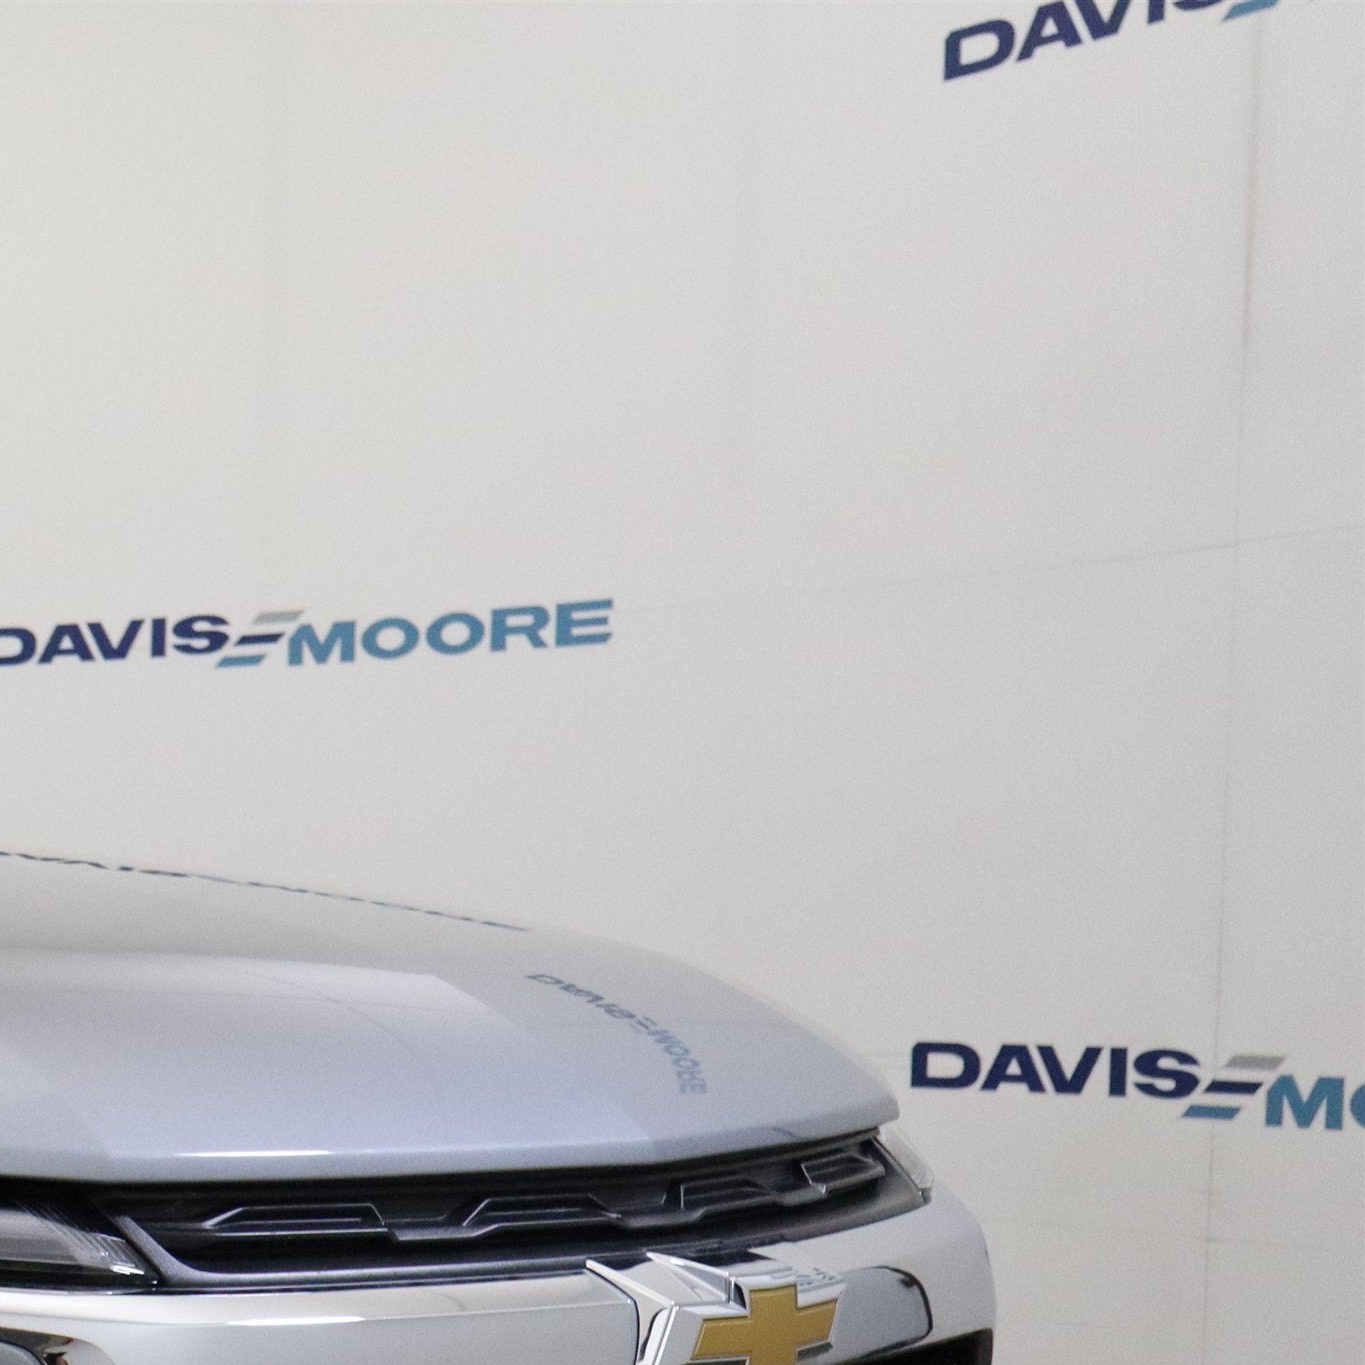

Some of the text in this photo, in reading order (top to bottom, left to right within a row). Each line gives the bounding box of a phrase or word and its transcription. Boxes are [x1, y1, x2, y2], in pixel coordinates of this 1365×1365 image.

[943, 0, 1222, 81] DAV
[285, 598, 614, 668] MOORE
[910, 1041, 1201, 1100] DAVIS
